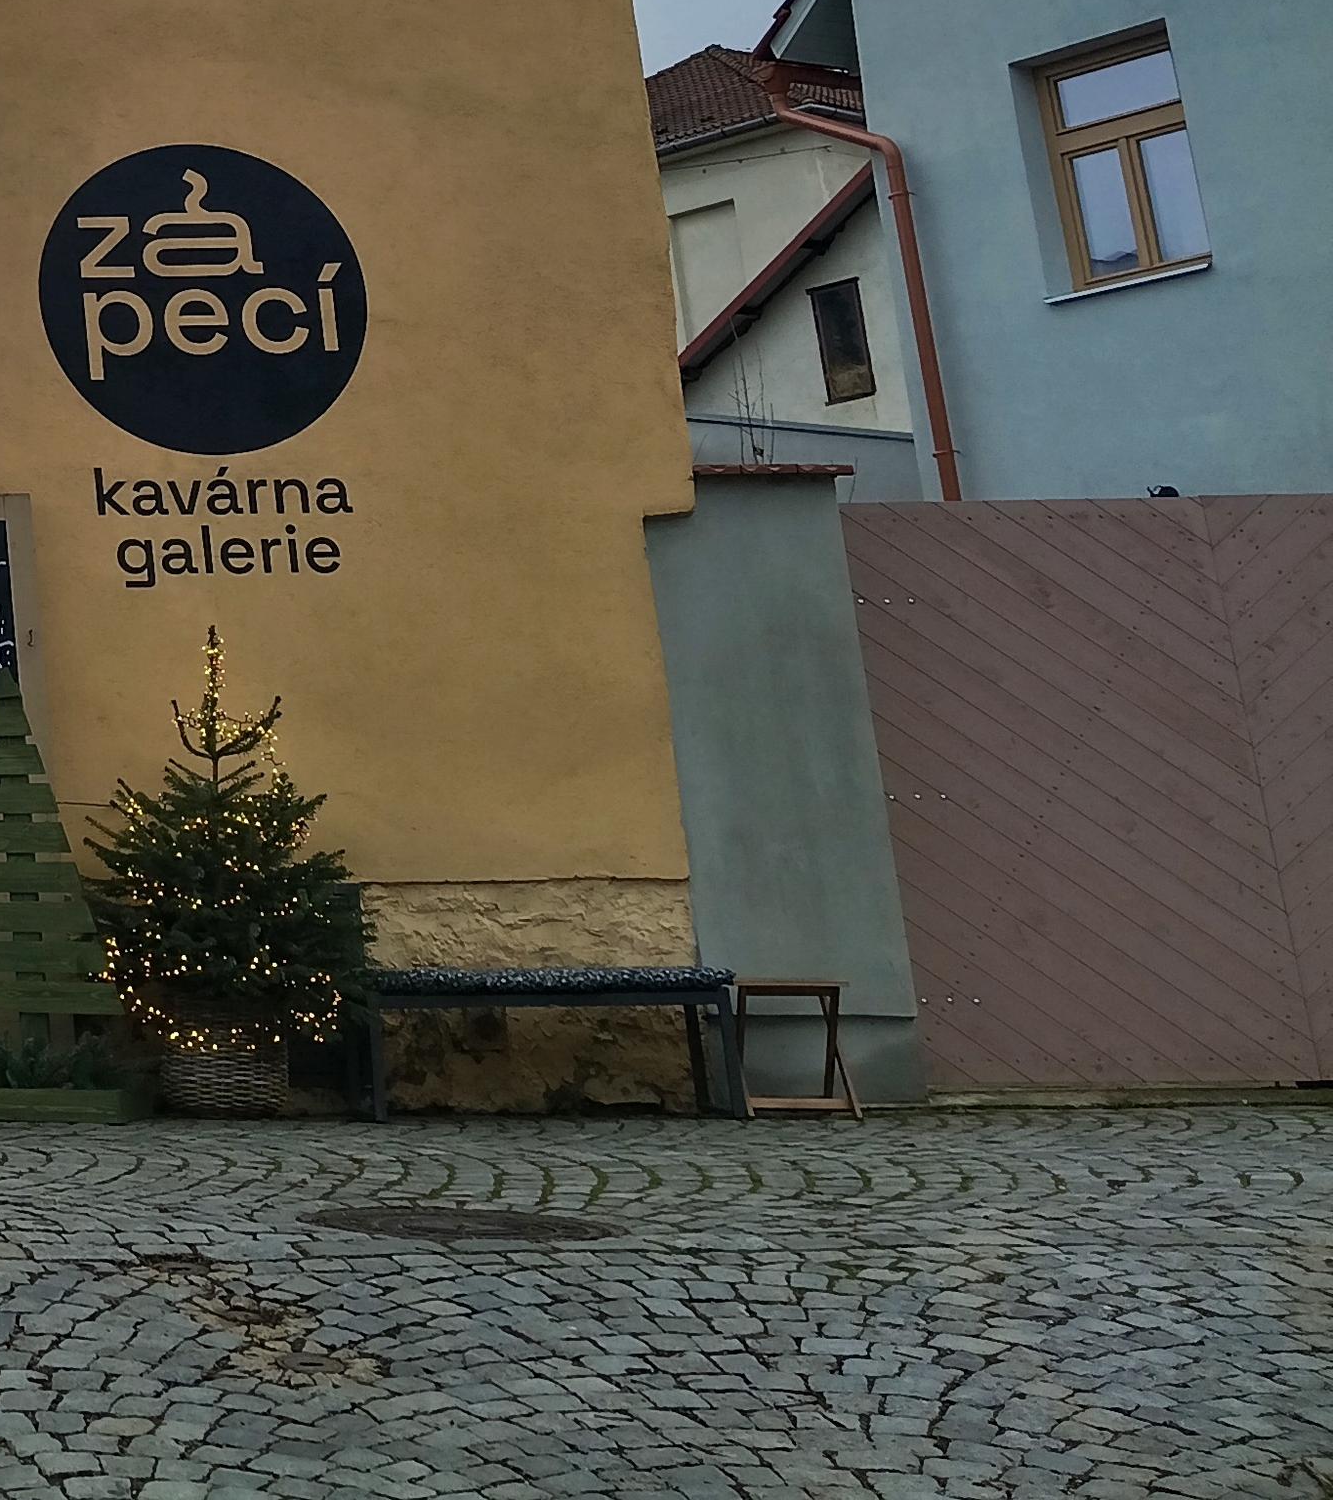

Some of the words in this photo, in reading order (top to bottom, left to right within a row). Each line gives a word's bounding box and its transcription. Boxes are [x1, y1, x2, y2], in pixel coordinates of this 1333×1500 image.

[83, 263, 342, 380] pecí
[93, 466, 354, 516] kavárna
[117, 524, 342, 588] galerie
